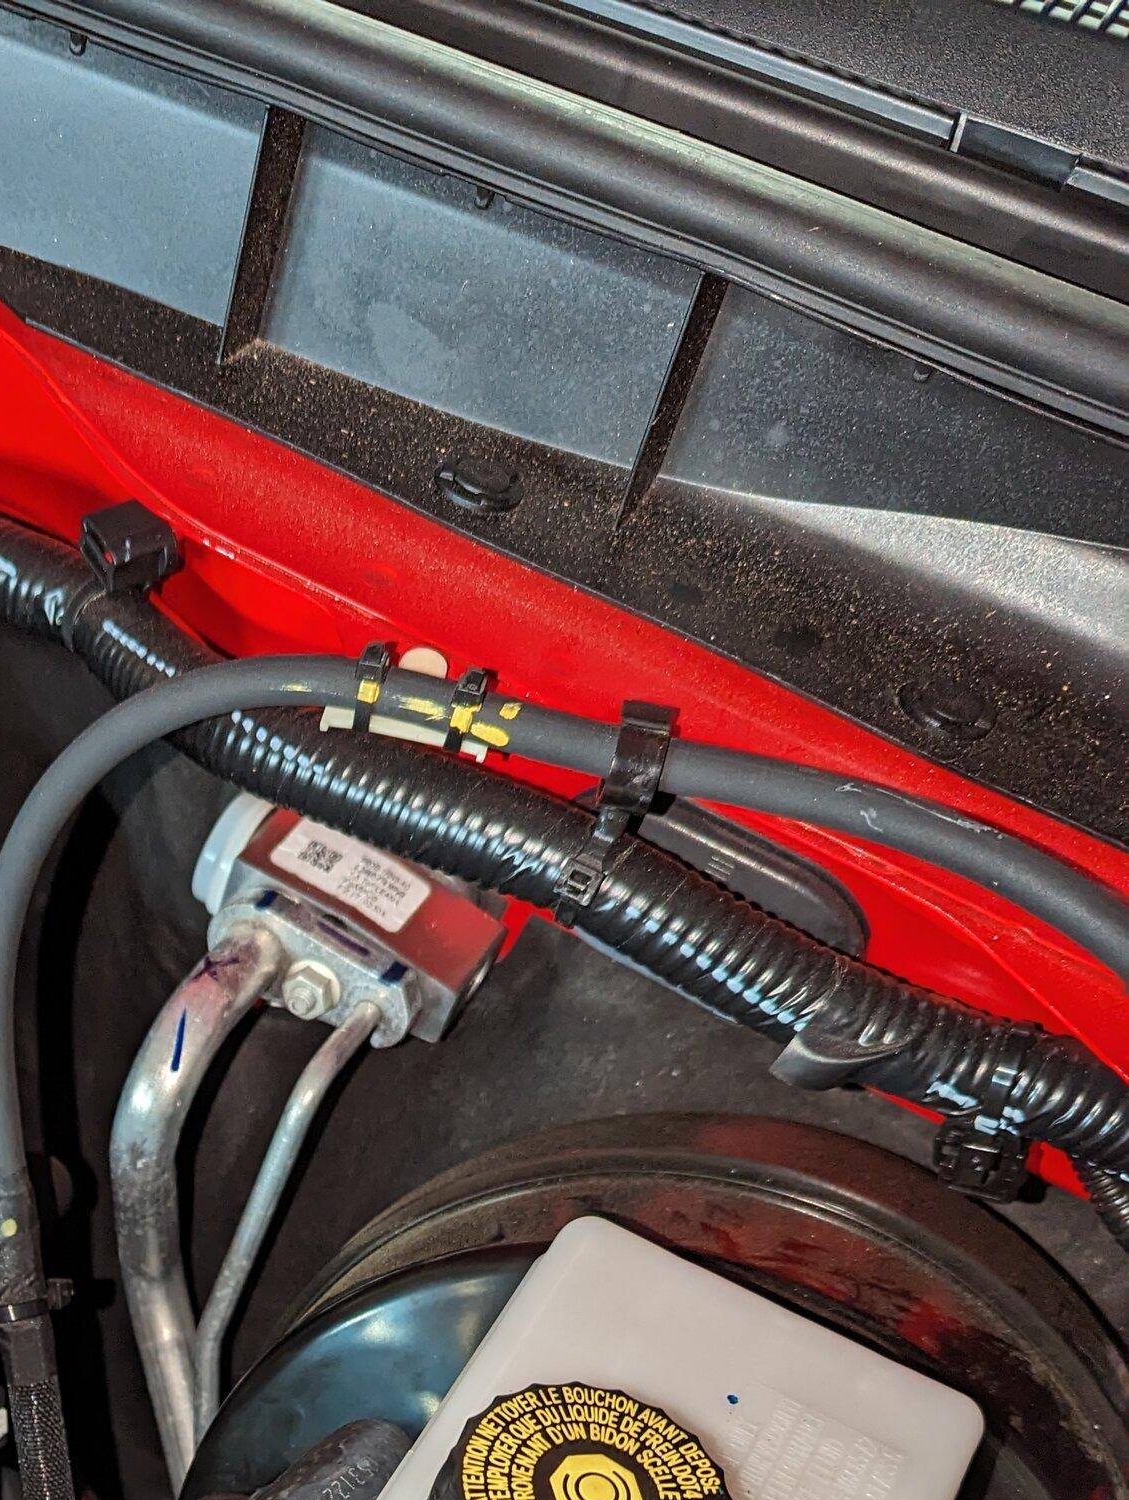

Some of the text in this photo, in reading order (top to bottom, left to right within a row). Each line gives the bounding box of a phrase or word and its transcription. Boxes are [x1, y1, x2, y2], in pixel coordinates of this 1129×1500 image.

[476, 1390, 542, 1441] NETTOYER
[540, 1387, 562, 1405] LE
[562, 1386, 638, 1416] BOUCHON
[638, 1410, 688, 1444] AVANT
[680, 1441, 721, 1496] DEPOSE
[512, 1414, 540, 1441] QUE
[542, 1408, 562, 1426] DU
[562, 1404, 619, 1428] LIQUIDE
[620, 1416, 642, 1436] DE
[546, 1422, 588, 1445] D'UN
[590, 1425, 640, 1456] BIDON
[636, 1448, 681, 1500] SCELLE
